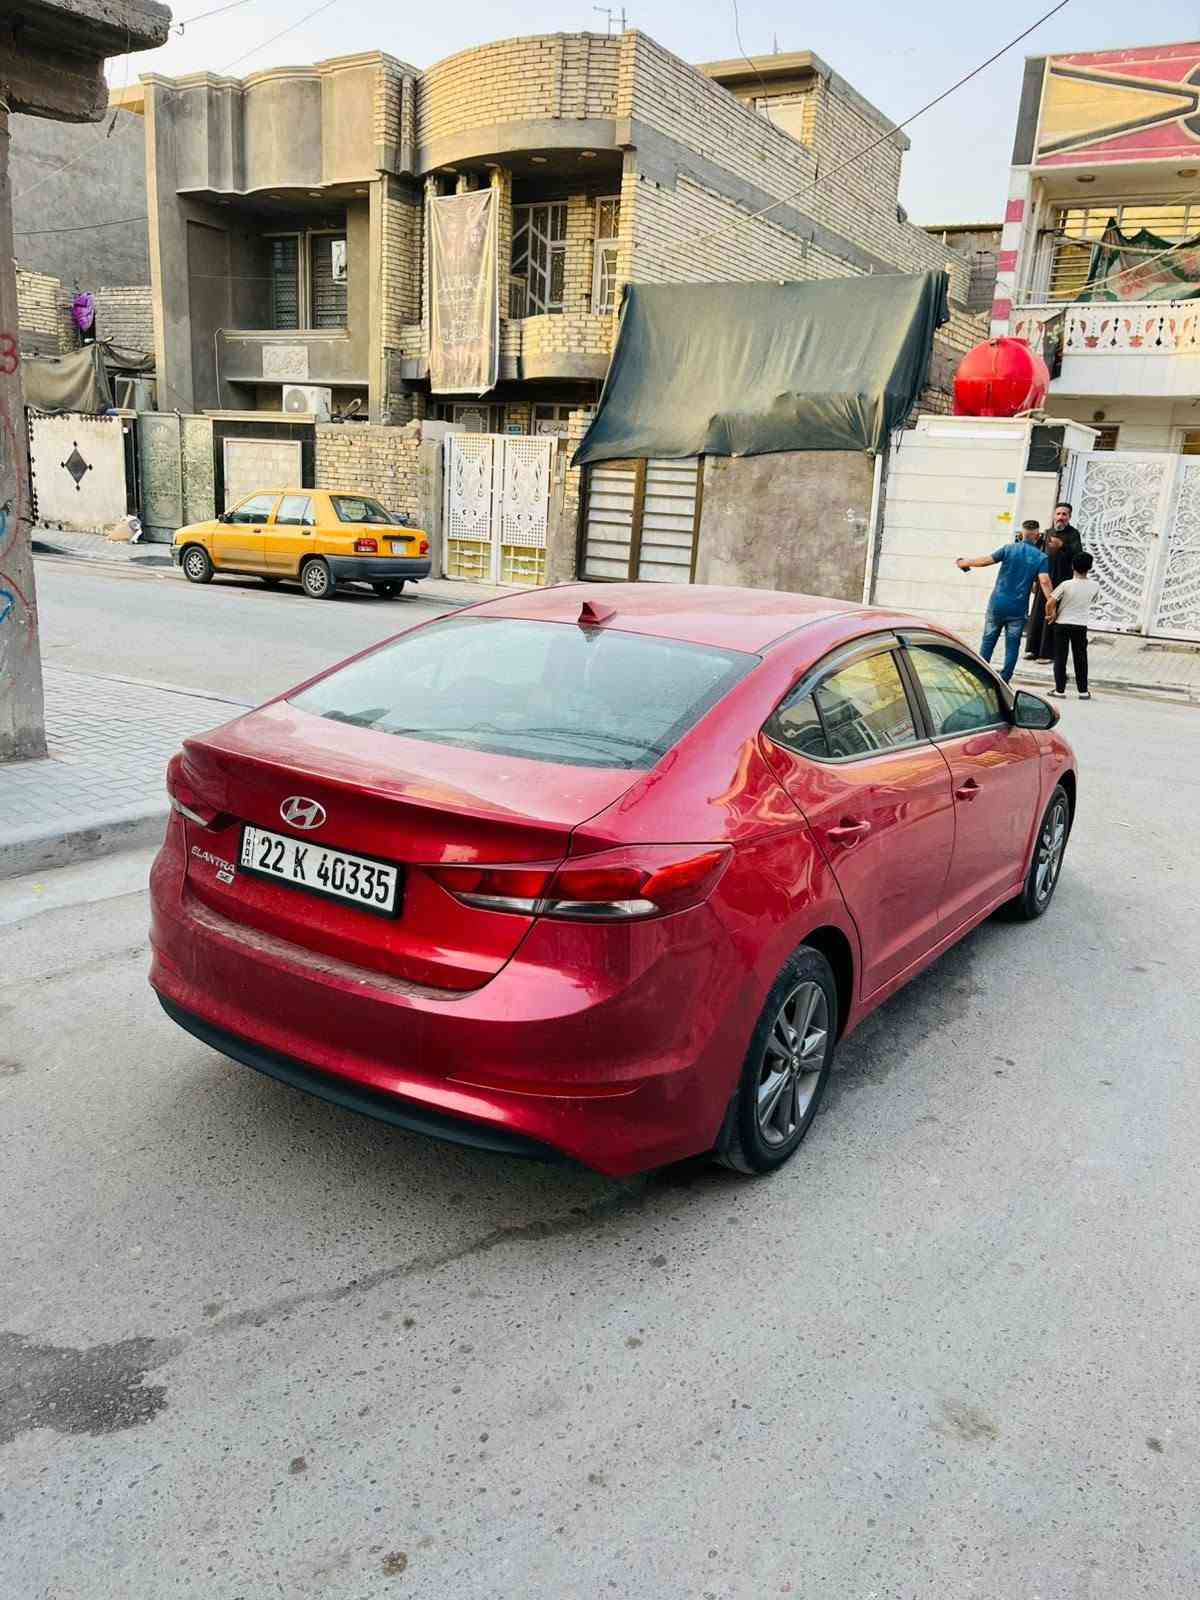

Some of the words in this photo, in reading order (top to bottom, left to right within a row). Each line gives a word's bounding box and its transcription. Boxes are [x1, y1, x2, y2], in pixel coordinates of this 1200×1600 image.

[191, 845, 235, 874] ELANTRA
[258, 836, 285, 873] 22
[293, 846, 309, 881] K
[317, 853, 390, 903] 40335
